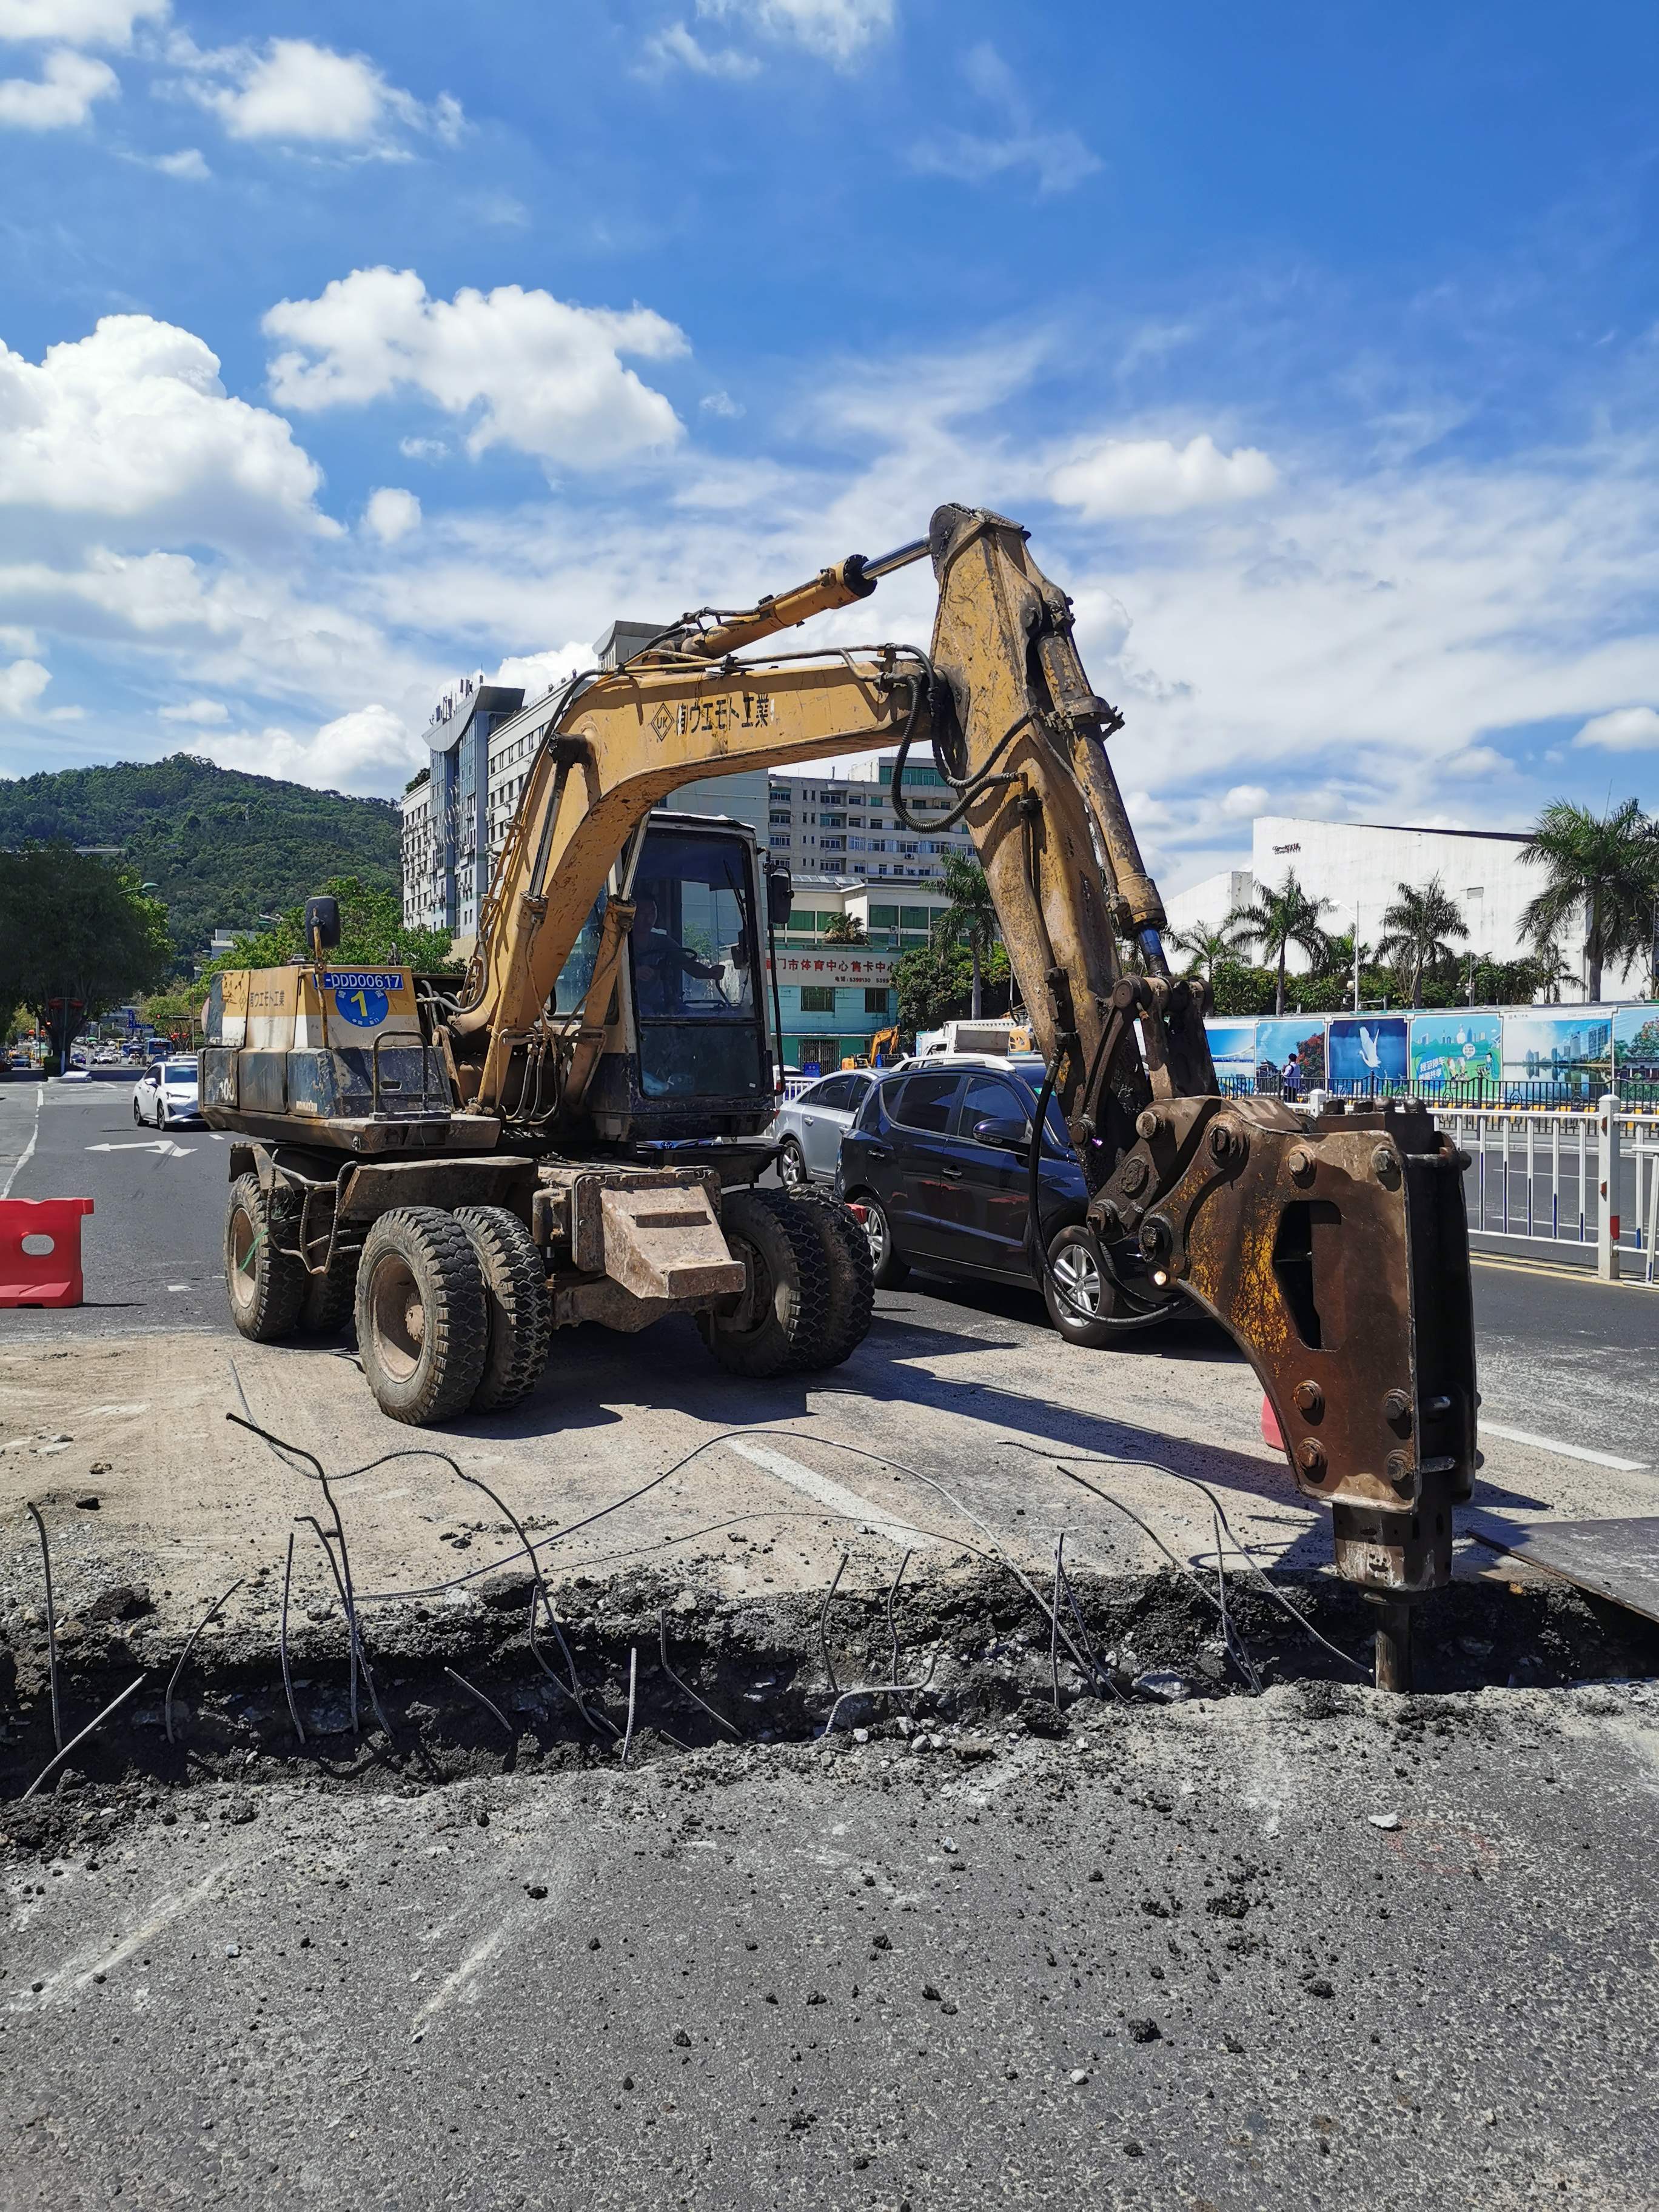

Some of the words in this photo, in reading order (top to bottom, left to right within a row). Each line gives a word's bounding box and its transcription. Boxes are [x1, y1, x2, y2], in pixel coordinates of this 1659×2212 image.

[657, 716, 668, 729] UK
[317, 973, 400, 988] -DDD00617
[350, 990, 368, 1017] 1
